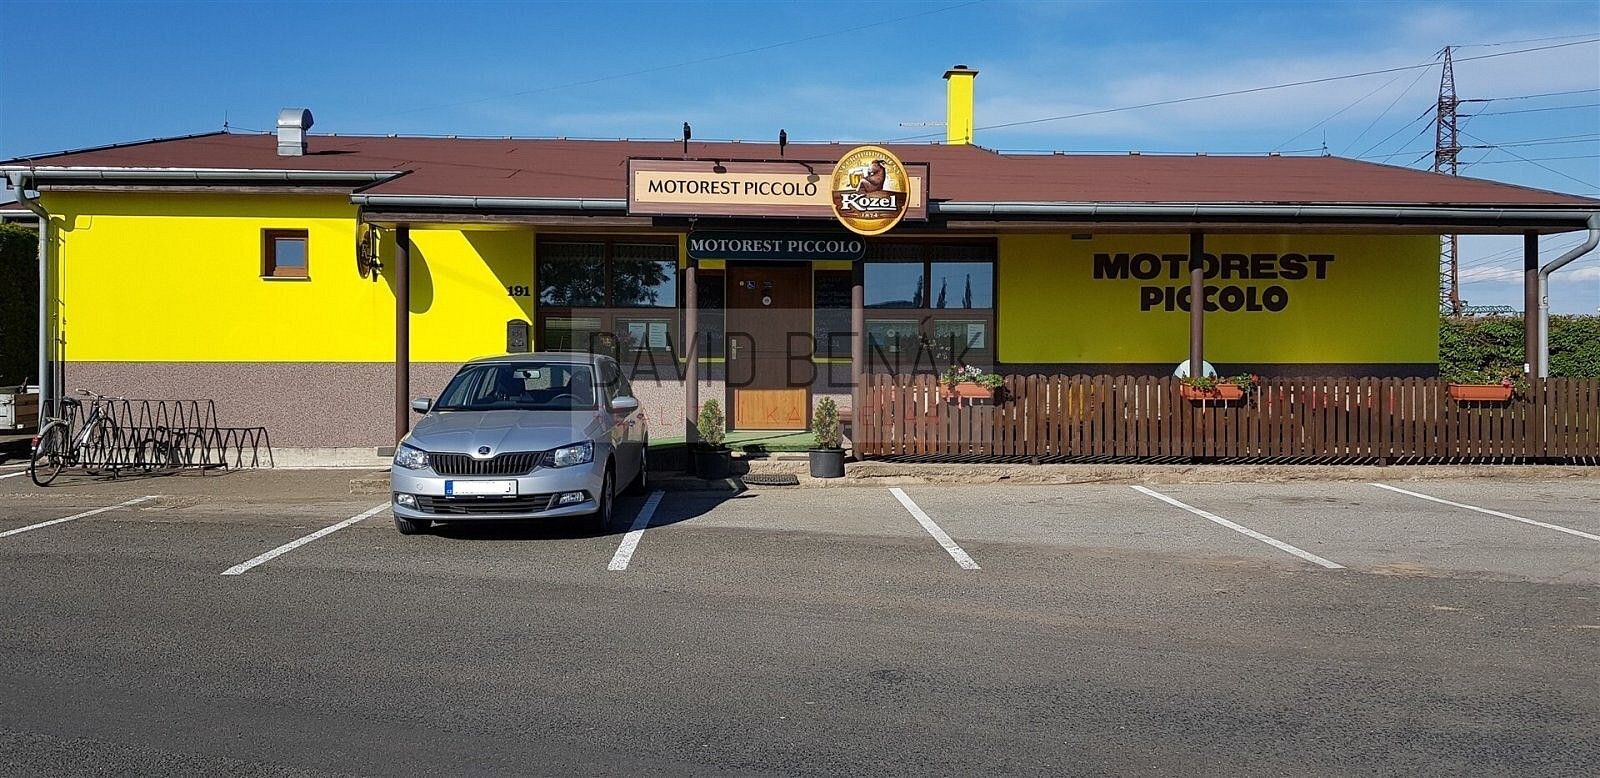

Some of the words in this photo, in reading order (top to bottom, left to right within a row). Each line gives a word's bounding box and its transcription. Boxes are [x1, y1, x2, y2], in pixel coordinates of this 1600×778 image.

[648, 179, 740, 195] MOTOREST
[744, 181, 817, 196] PICCOLO
[841, 193, 897, 211] Kozel
[690, 239, 782, 252] MOTOREST
[788, 240, 861, 253] PICCOLO
[1093, 253, 1334, 280] MOTOREST
[508, 286, 531, 297] 191
[1140, 285, 1288, 312] PICCOLO
